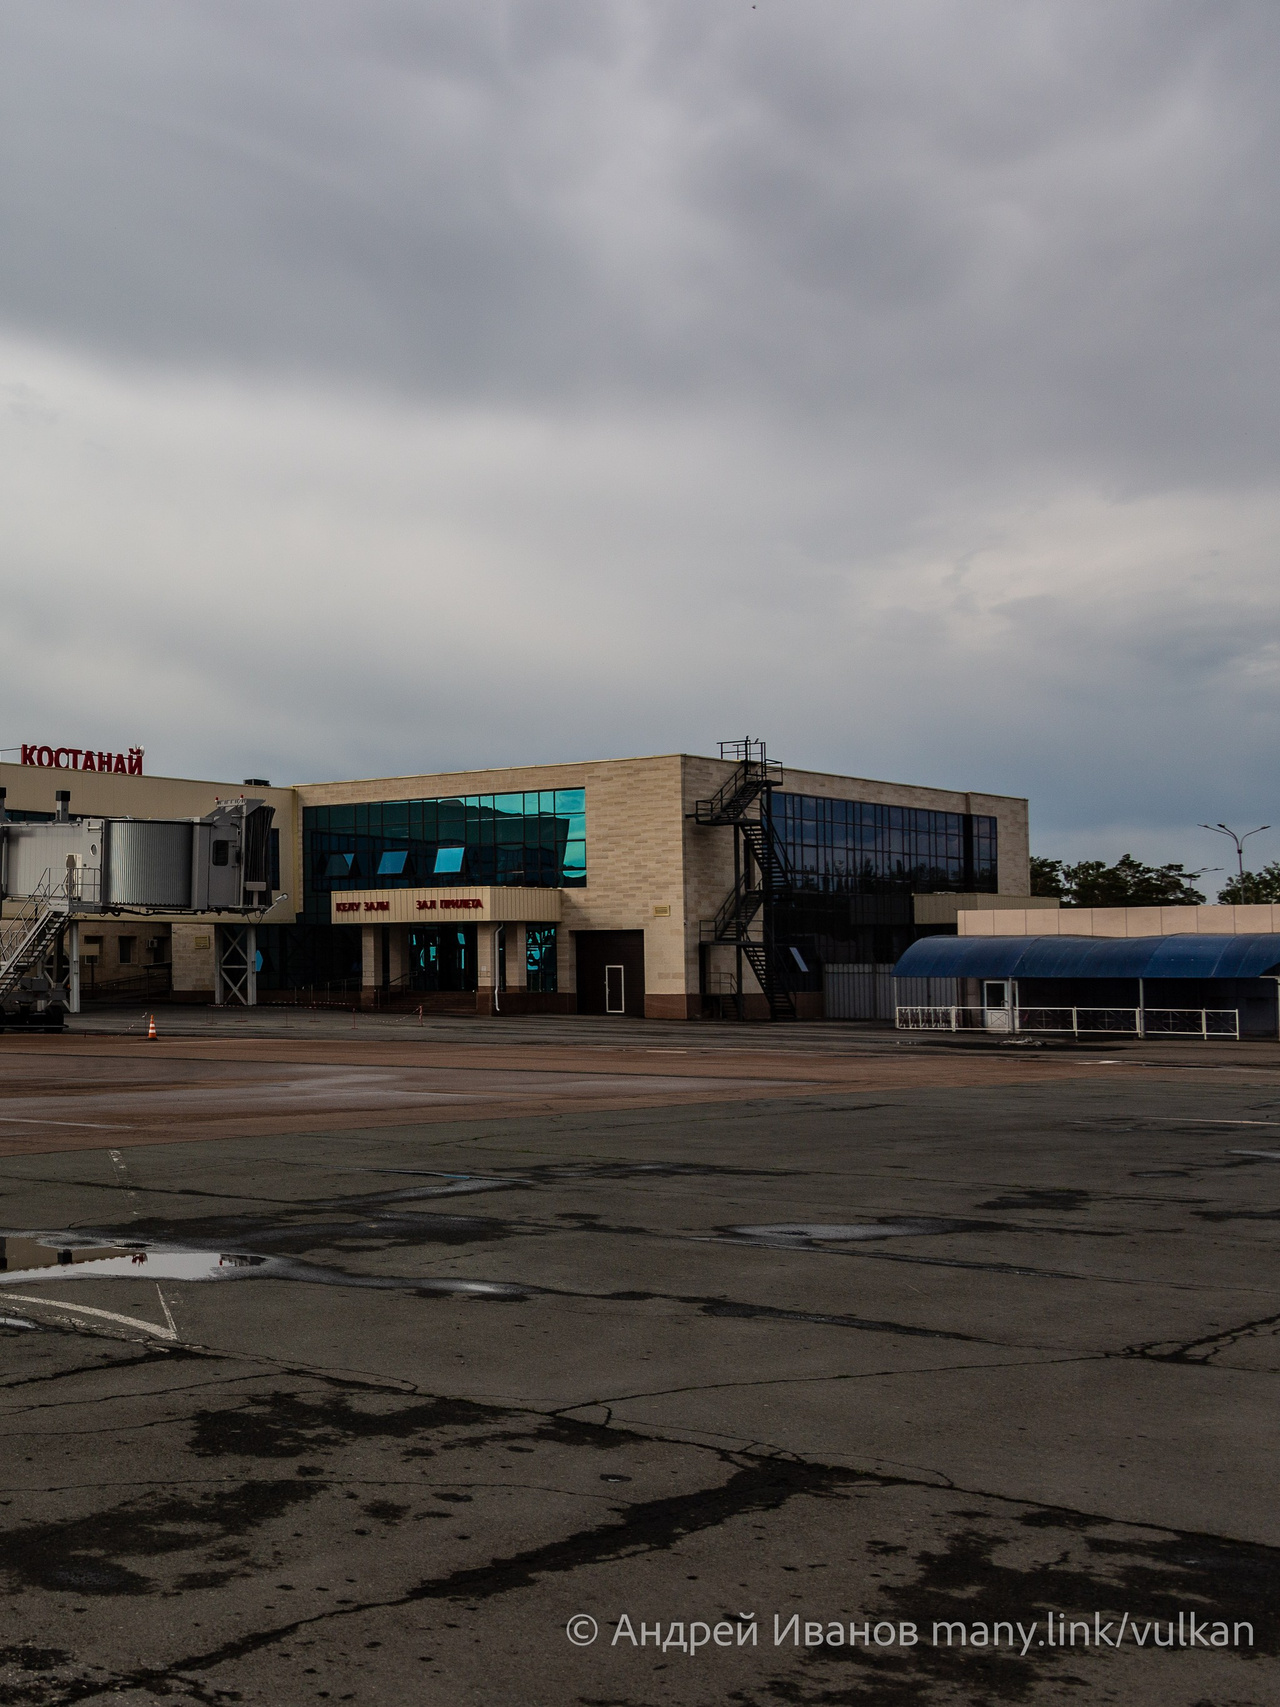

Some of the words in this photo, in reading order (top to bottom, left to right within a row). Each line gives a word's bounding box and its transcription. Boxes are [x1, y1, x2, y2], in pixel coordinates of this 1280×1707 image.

[21, 744, 143, 776] КОСТАНАЙ
[416, 899, 437, 910] ЗАЛ
[439, 898, 485, 909] ПРИЛЕТА
